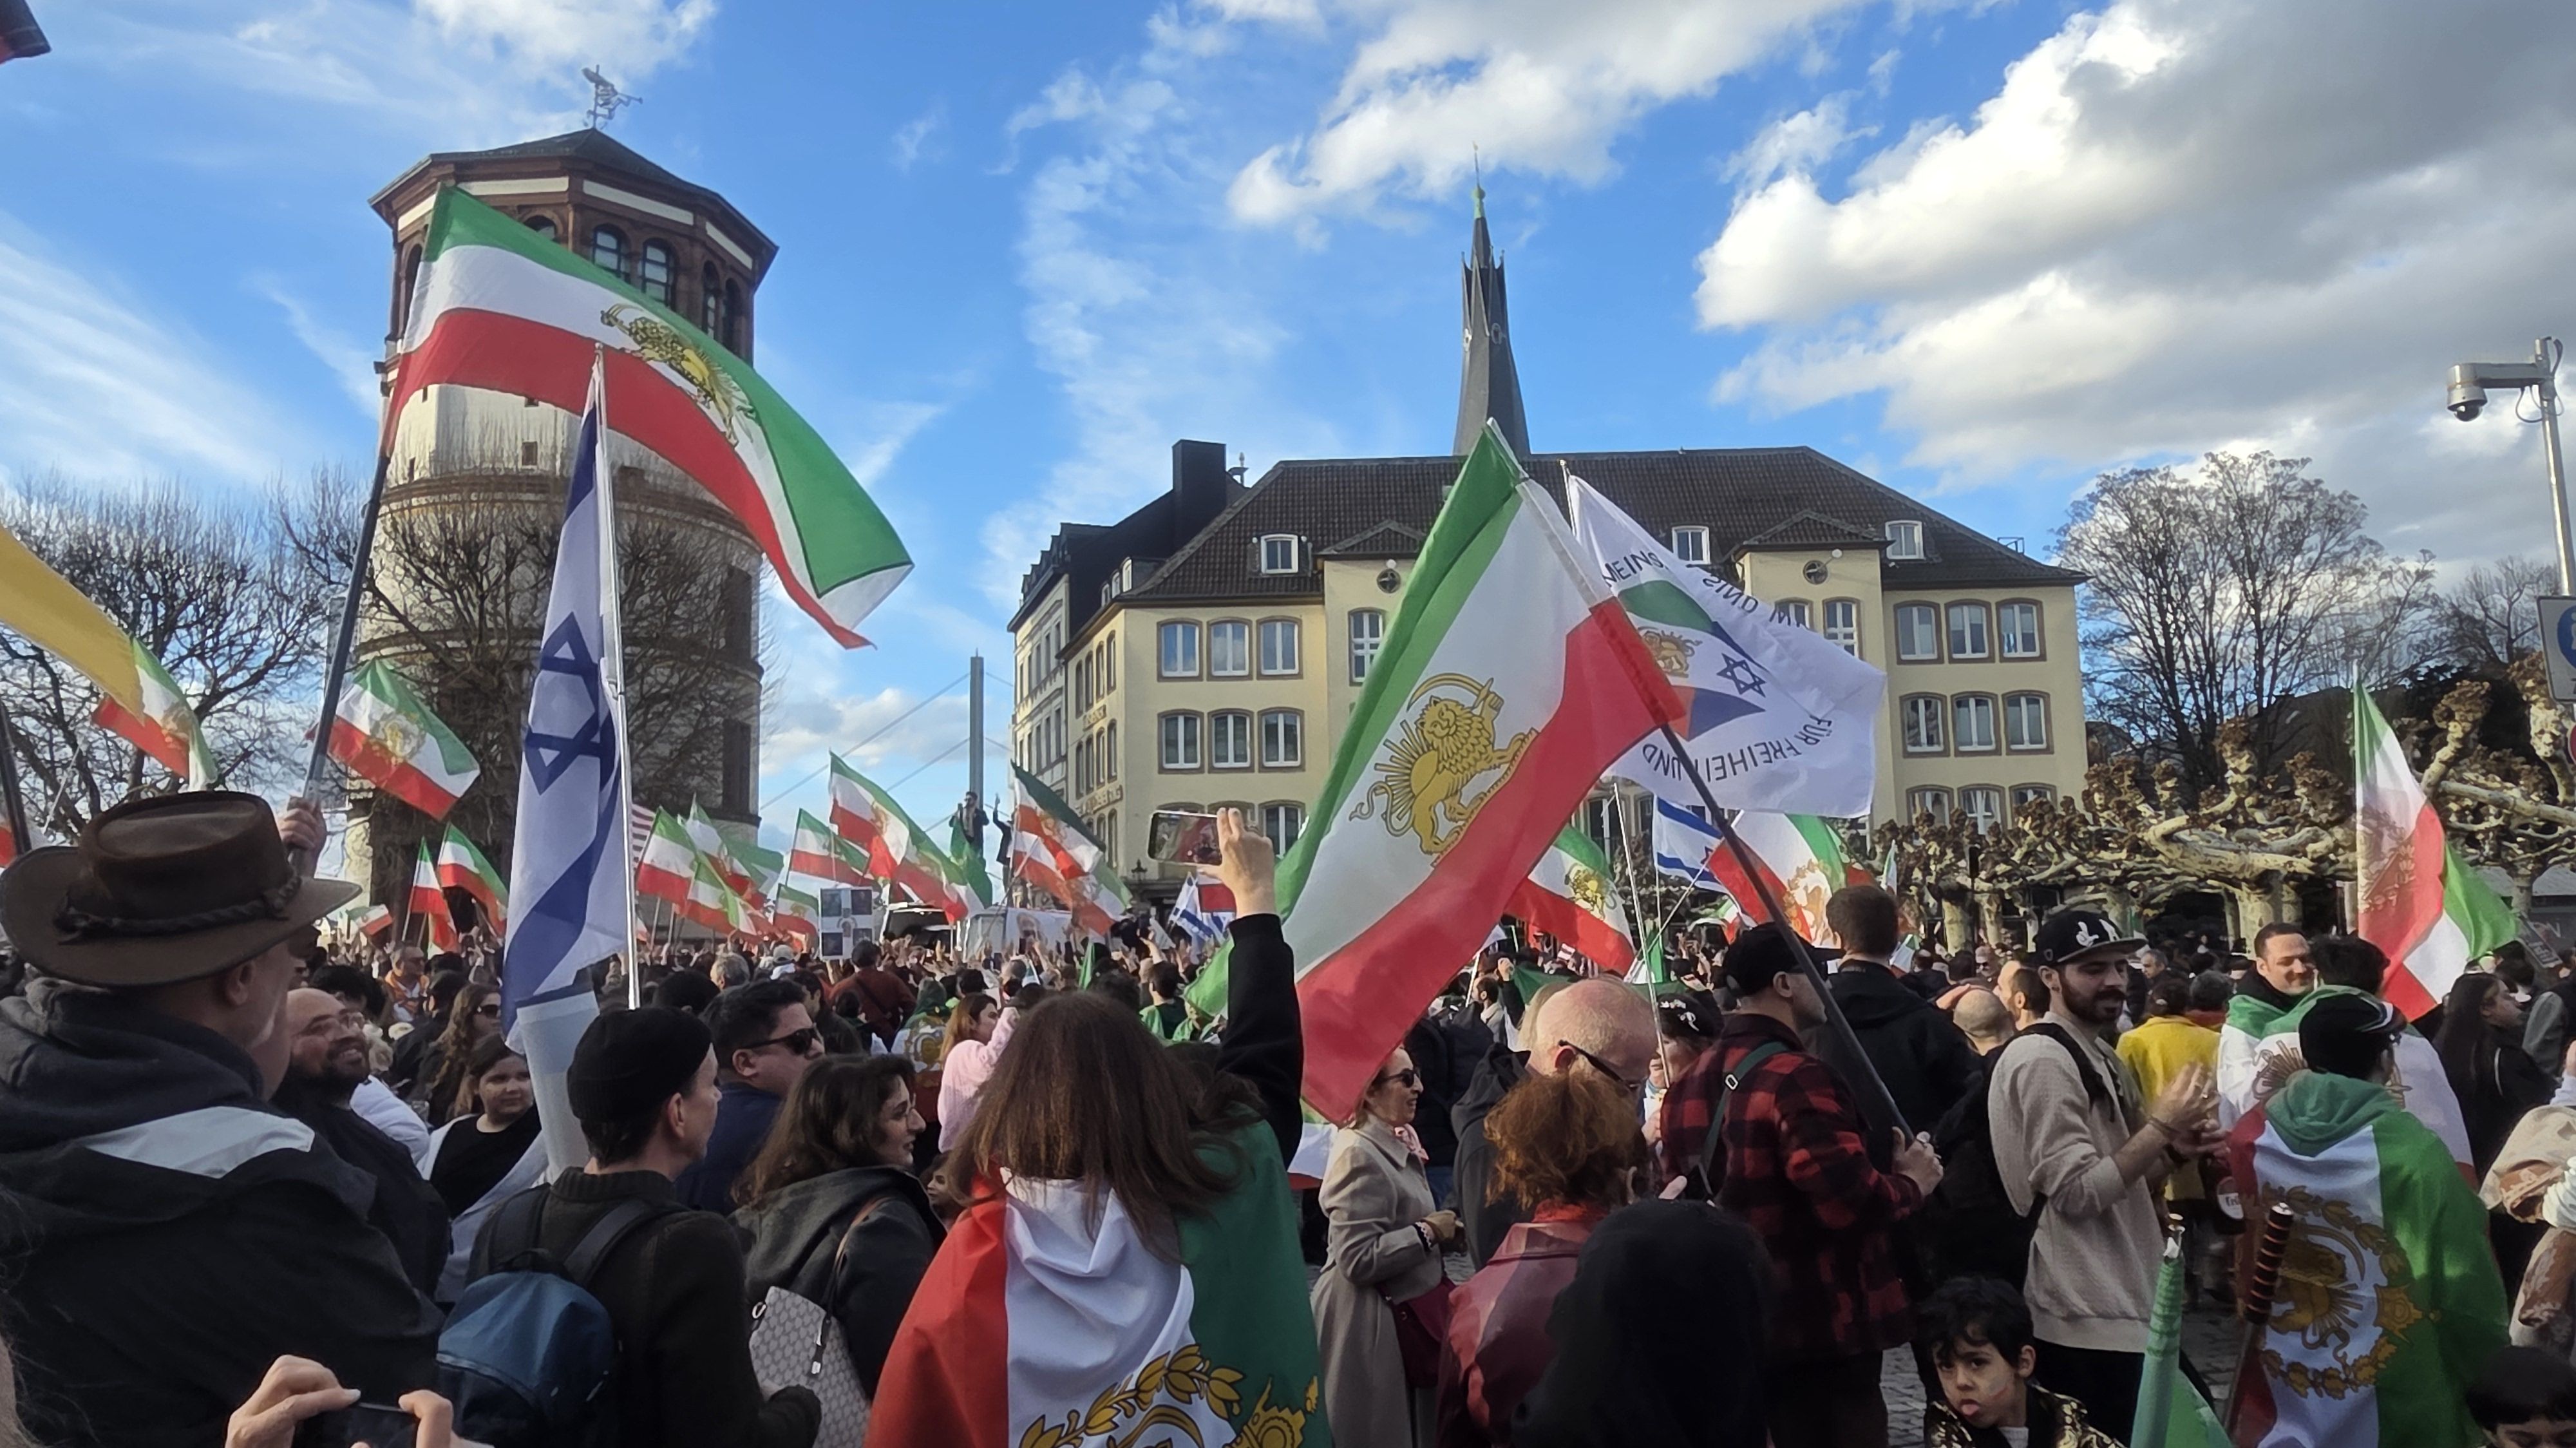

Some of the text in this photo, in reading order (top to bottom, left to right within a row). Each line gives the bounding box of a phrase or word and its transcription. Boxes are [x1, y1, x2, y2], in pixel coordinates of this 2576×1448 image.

[1602, 550, 1669, 587] MEINS
[1794, 714, 1832, 745] FÜR
[1643, 743, 1681, 781] UND
